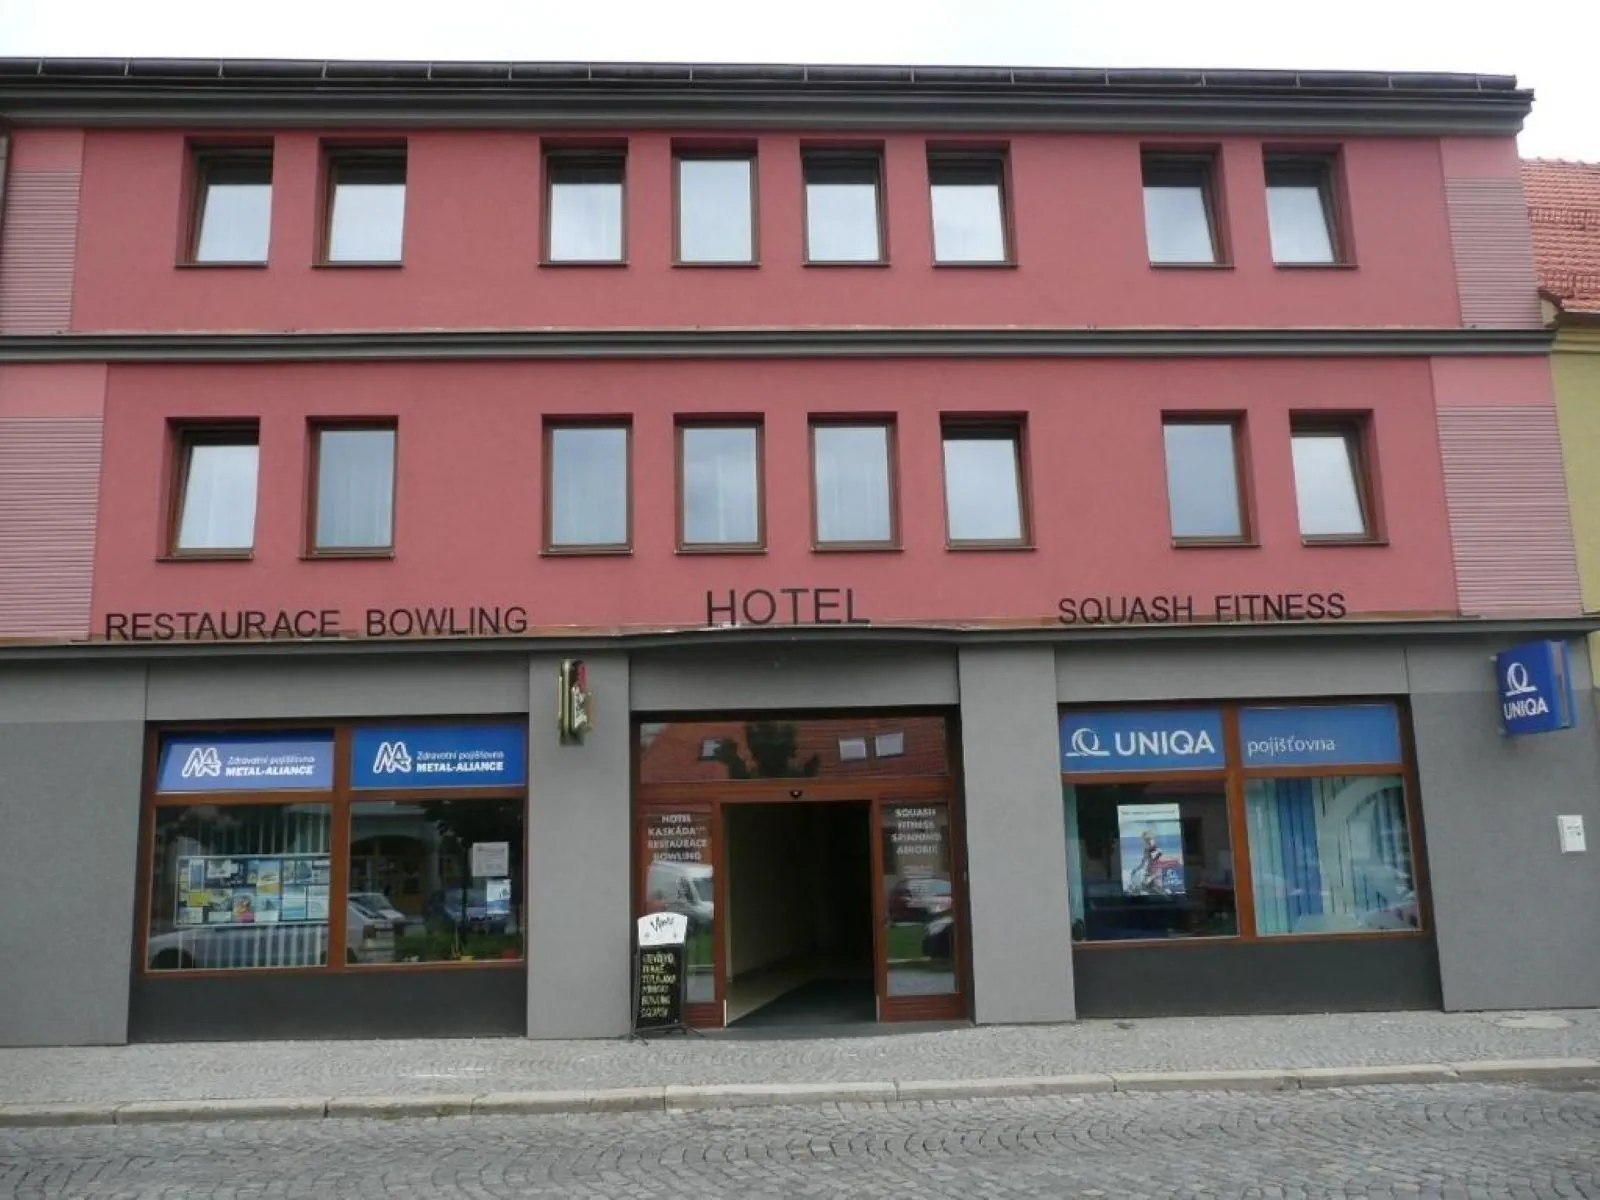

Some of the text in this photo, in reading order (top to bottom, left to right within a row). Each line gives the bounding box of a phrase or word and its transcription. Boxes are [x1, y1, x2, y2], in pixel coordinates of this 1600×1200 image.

[707, 588, 871, 627] HOTEL
[1058, 592, 1347, 625] SQUASH FITNESS
[105, 606, 528, 641] RESTAURACE BOWLING
[1503, 697, 1549, 720] UNIQA
[1113, 729, 1217, 756] UNIQA
[1247, 736, 1336, 757] pojišťovna
[225, 765, 314, 777] METAL-ALIANCE
[416, 761, 504, 773] METAL-ALIANCE
